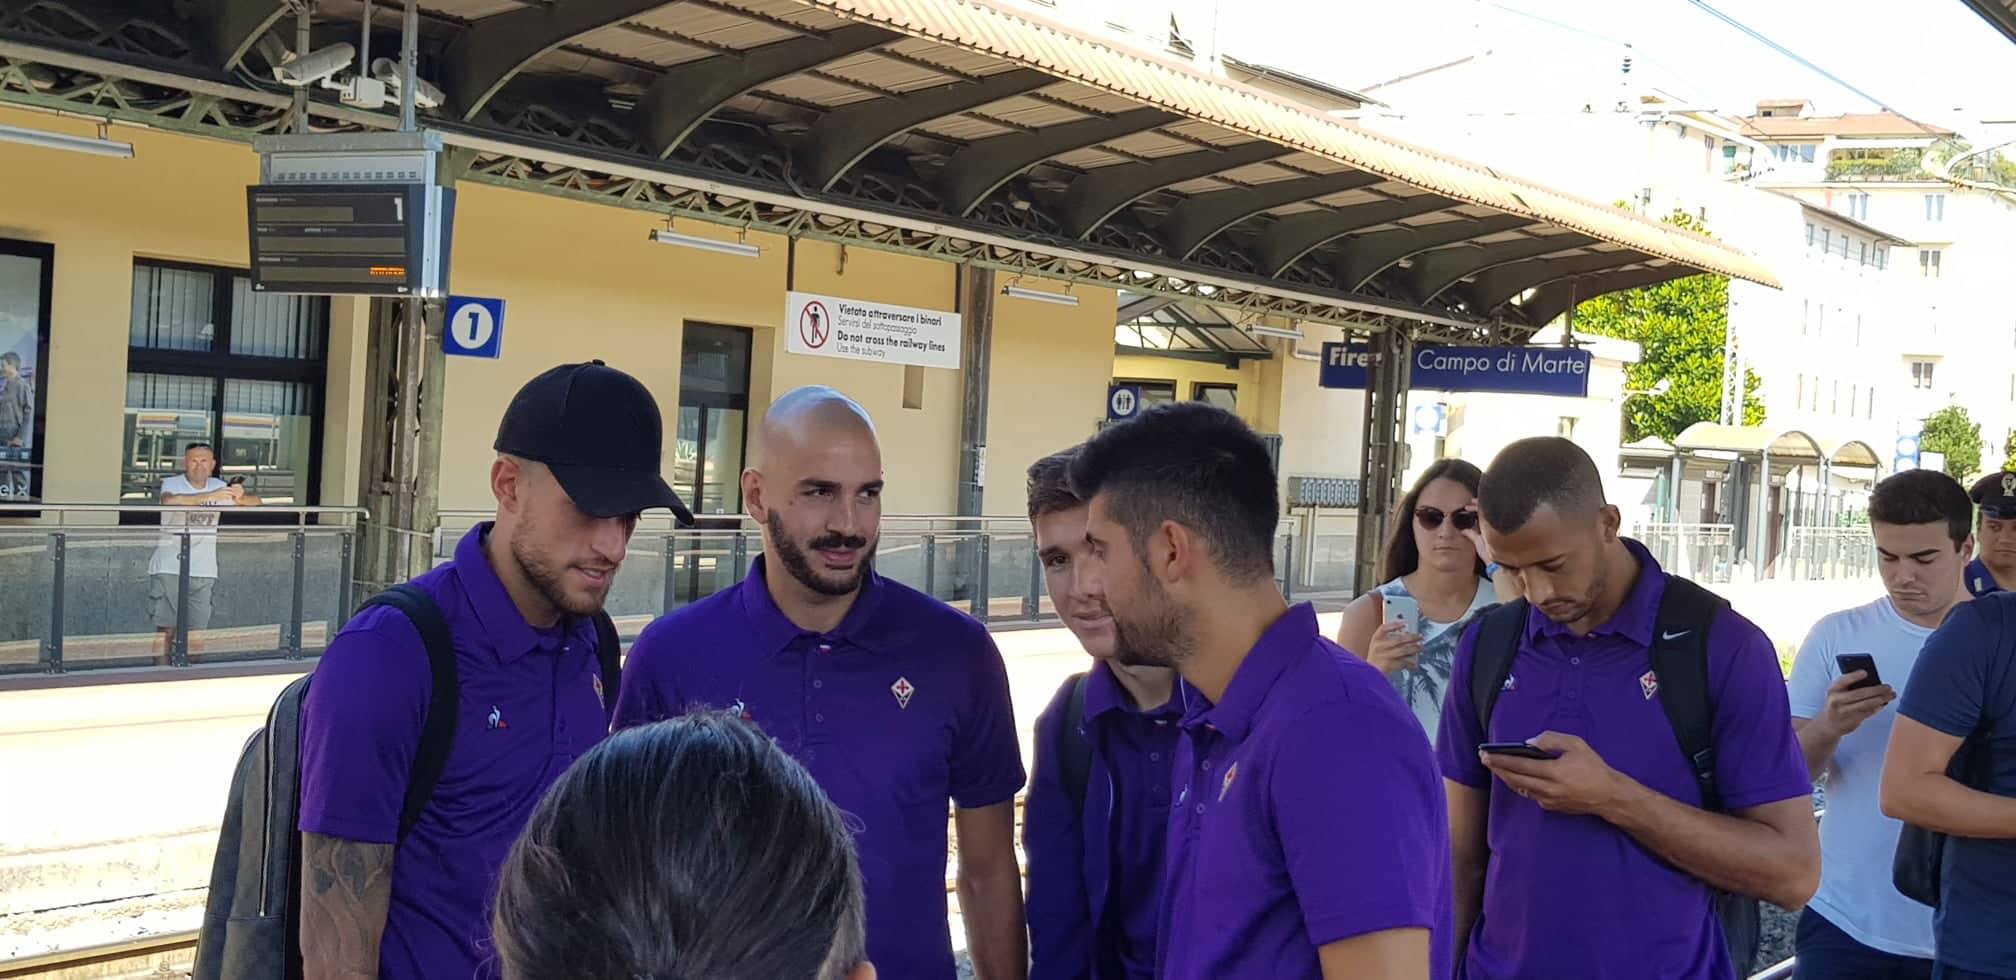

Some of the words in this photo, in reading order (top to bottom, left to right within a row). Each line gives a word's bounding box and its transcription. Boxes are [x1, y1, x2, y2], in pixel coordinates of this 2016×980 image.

[394, 197, 403, 221] 1
[468, 312, 479, 340] 1
[839, 304, 867, 316] Vietato
[868, 309, 915, 323] attraversare
[920, 313, 942, 327] binari
[862, 318, 872, 329] del
[836, 342, 849, 353] Use
[849, 344, 860, 355] the
[862, 345, 886, 359] subway
[837, 330, 849, 341] Do
[850, 333, 863, 343] not
[865, 335, 885, 345] cross
[886, 336, 899, 347] the
[899, 338, 927, 352] railway
[928, 340, 946, 352] lines
[1329, 346, 1384, 368] Fire
[1417, 349, 1490, 375] Campo
[1496, 351, 1515, 372] di
[1521, 352, 1585, 375] Marte
